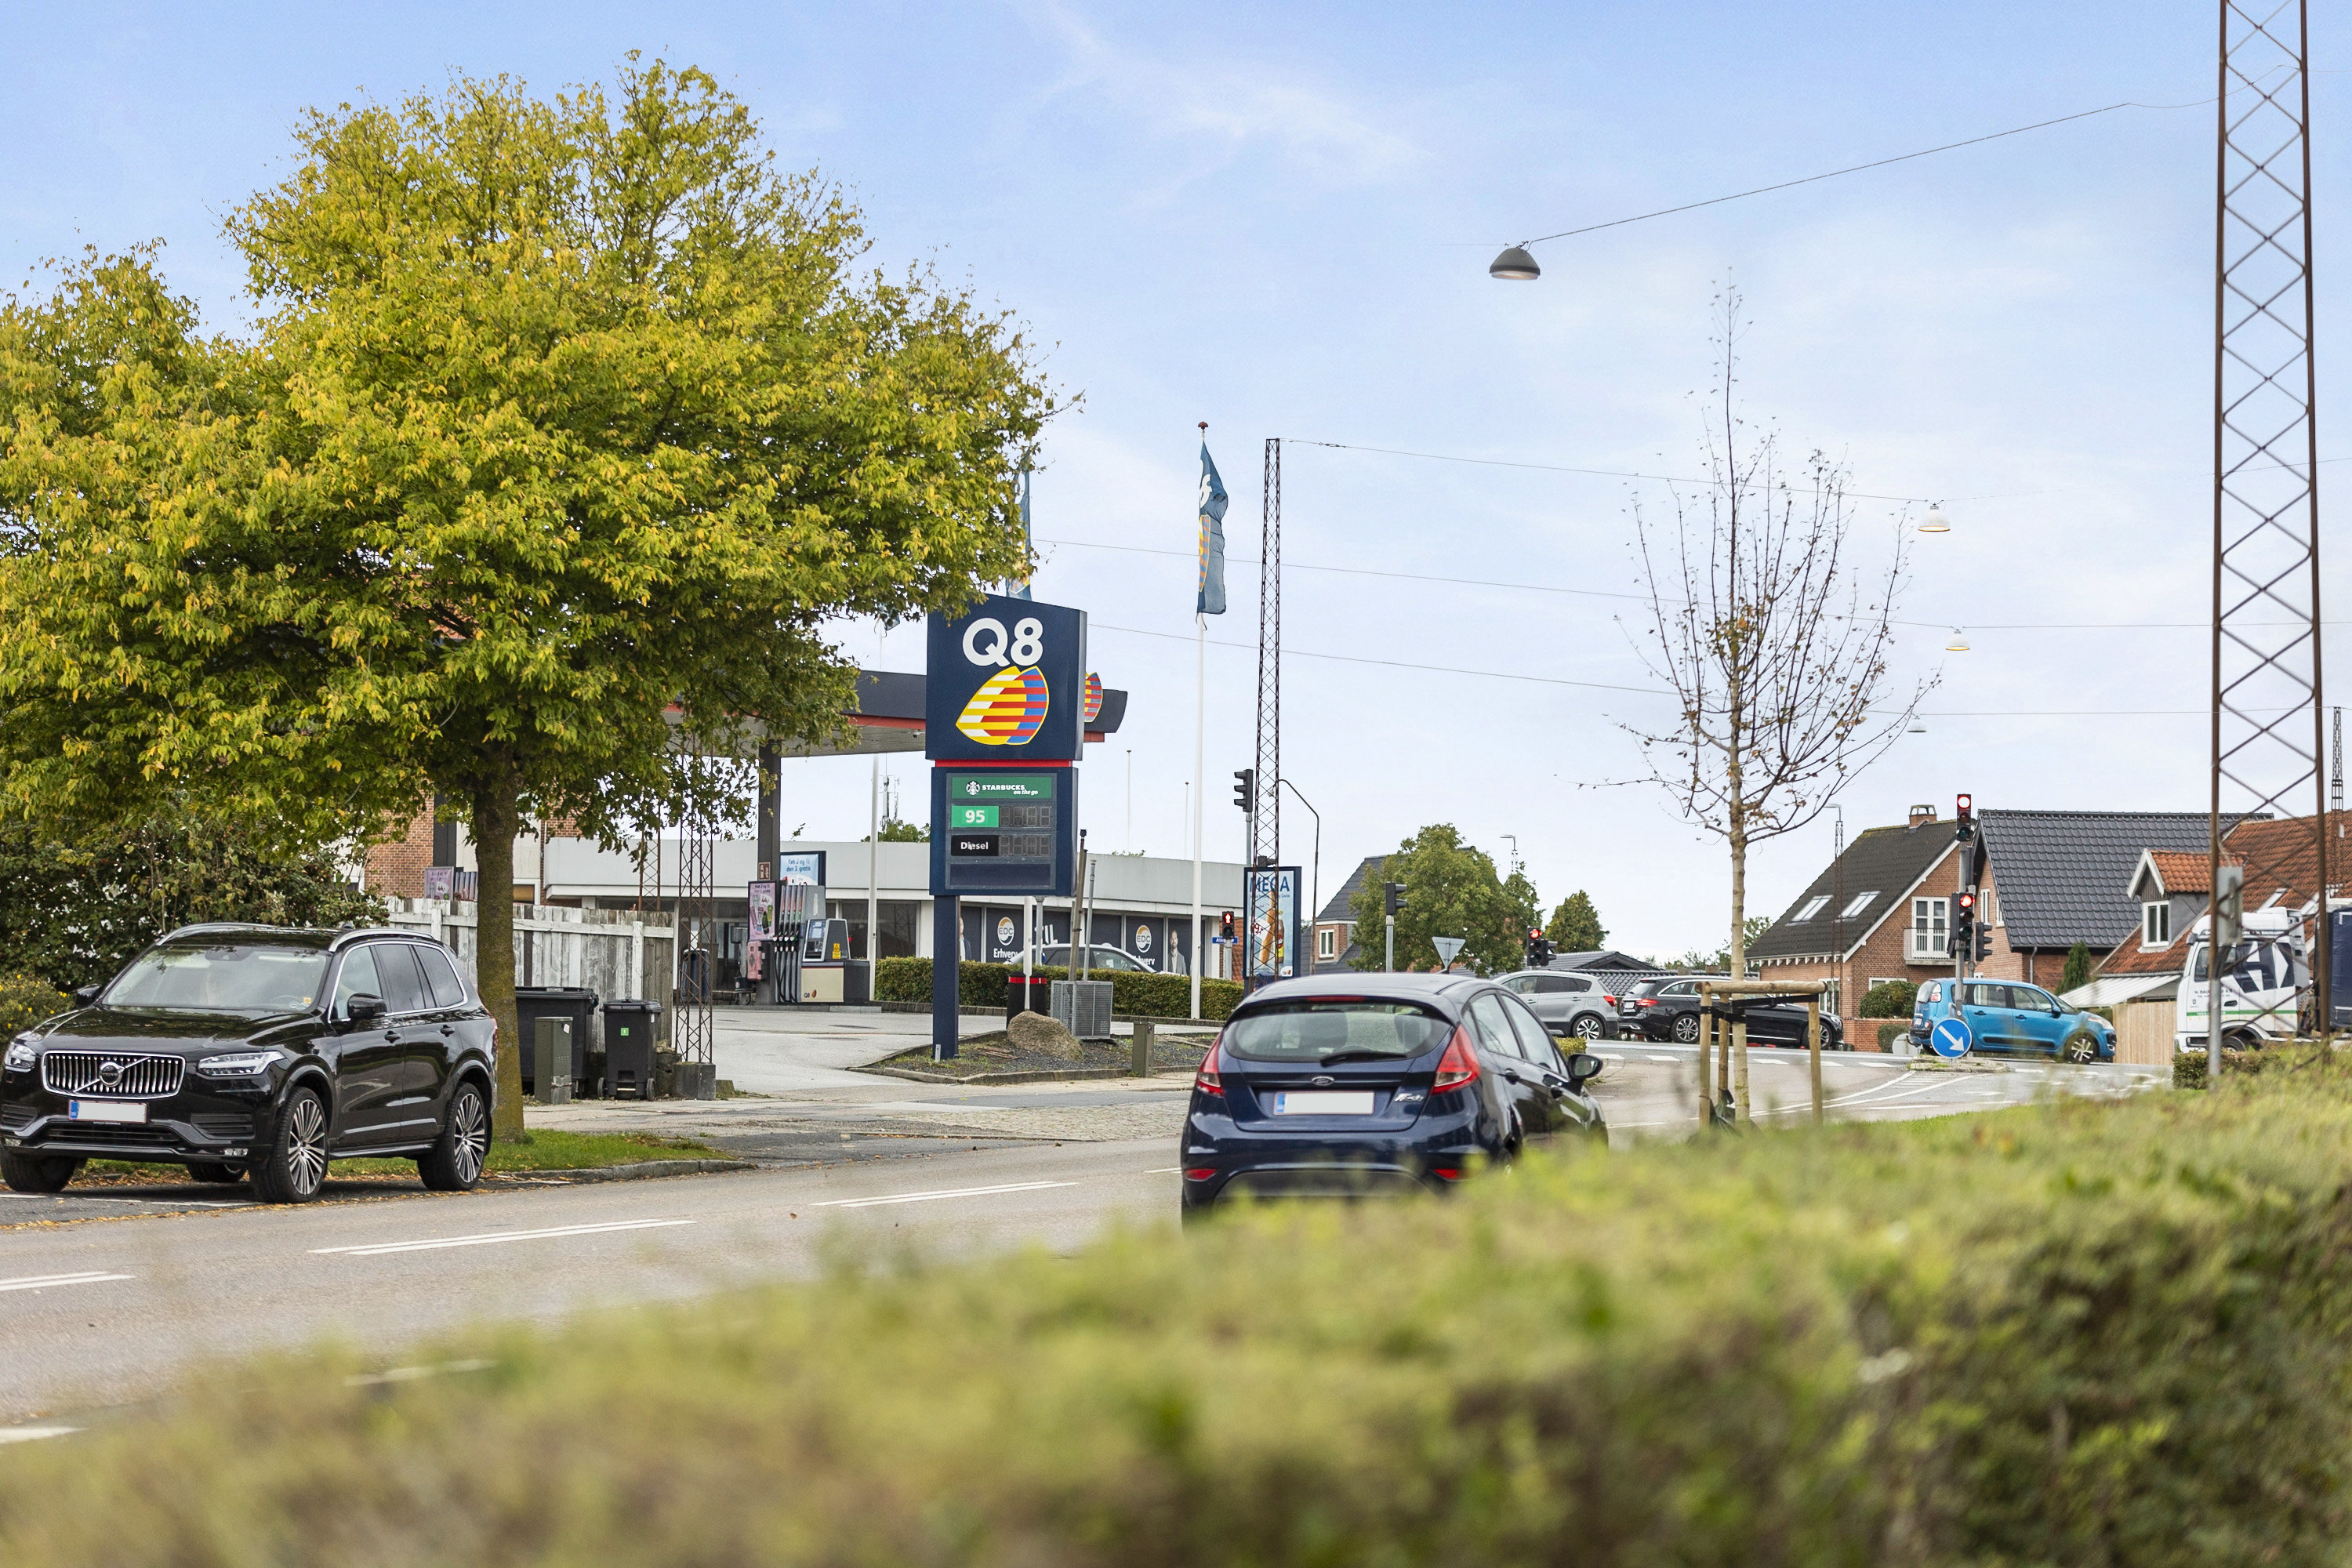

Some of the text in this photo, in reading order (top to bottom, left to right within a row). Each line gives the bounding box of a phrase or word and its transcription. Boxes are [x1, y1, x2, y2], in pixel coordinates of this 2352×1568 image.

[962, 617, 1044, 667] Q8
[965, 810, 985, 823] 95
[960, 841, 989, 851] Diesel
